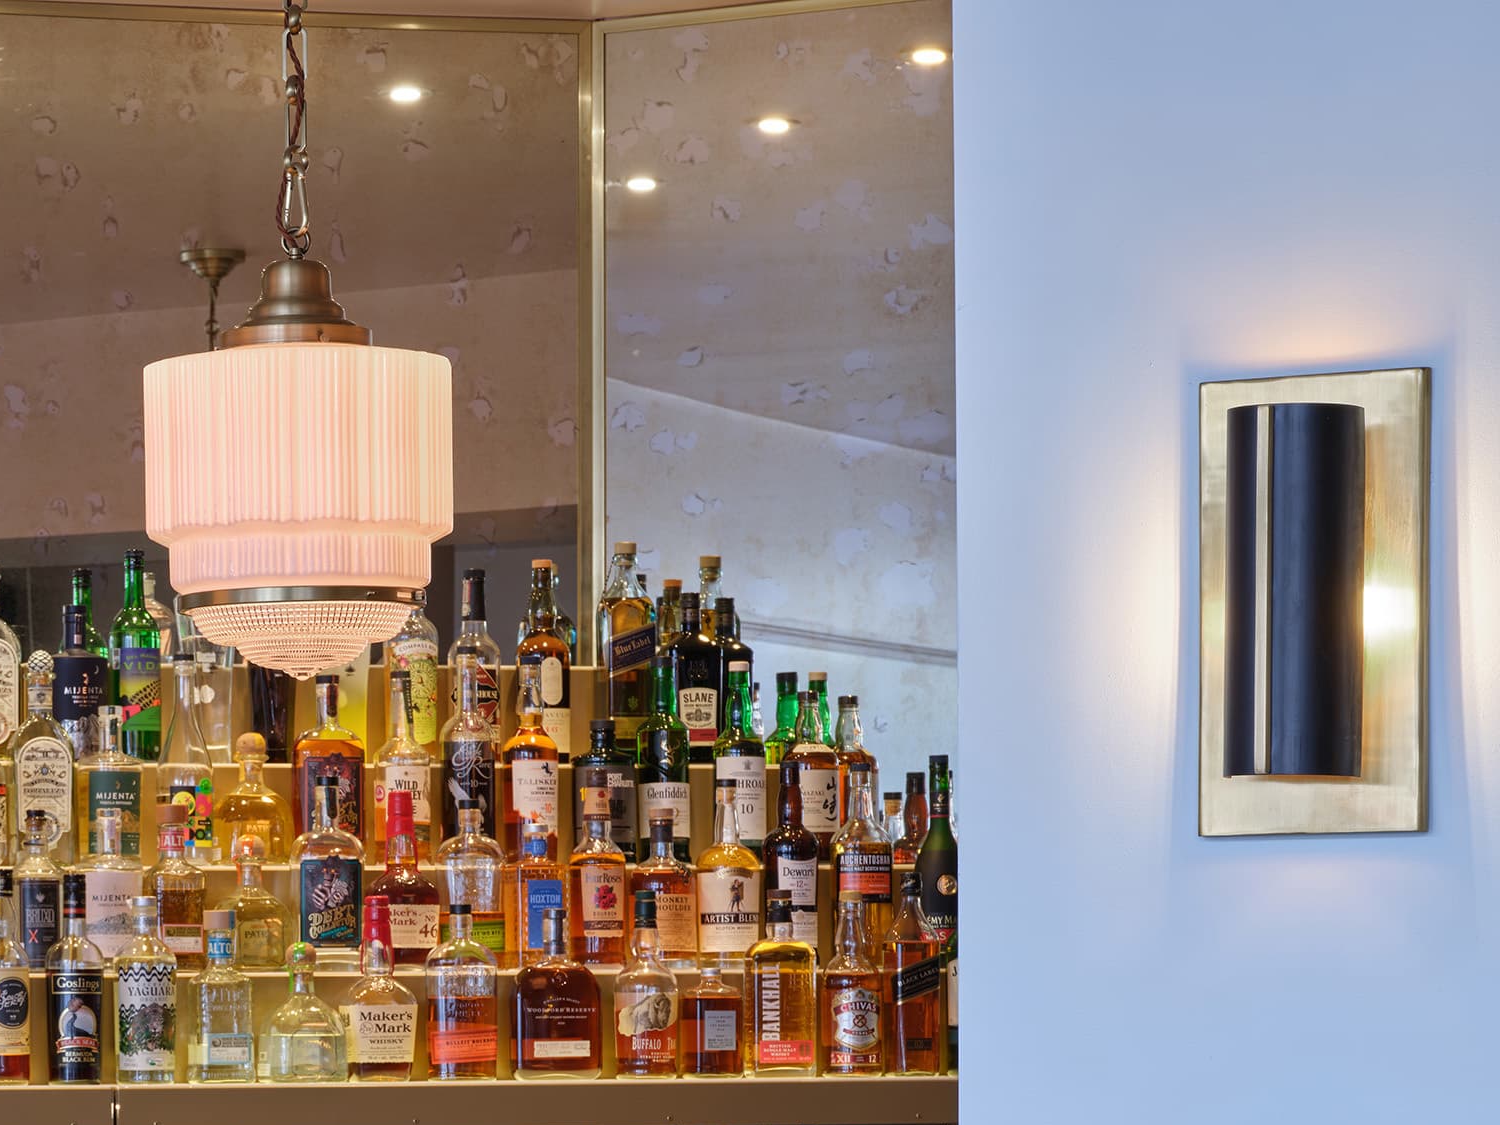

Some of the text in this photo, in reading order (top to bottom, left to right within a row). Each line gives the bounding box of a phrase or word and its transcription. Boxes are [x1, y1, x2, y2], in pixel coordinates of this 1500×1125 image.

[64, 687, 103, 695] MIJENTA
[683, 693, 714, 704] SLANE
[395, 780, 418, 790] WILD
[96, 792, 134, 801] MIJENTA
[741, 804, 754, 814] 10
[164, 836, 184, 847] ALT
[840, 854, 891, 866] AUCHENTOSHAN
[603, 872, 622, 882] Roses
[530, 894, 561, 904] HOXTON
[704, 914, 735, 923] ARTIST
[27, 929, 39, 943] X
[419, 924, 438, 939] 46
[208, 944, 232, 954] ALTO
[56, 976, 100, 993] Goslings
[762, 963, 780, 1041] BANKHALL
[840, 1002, 878, 1014] CHIVAS
[359, 1011, 413, 1022] Maker's
[374, 1023, 412, 1034] Mark
[632, 1036, 662, 1051] BUFFALO
[836, 1055, 851, 1064] XII
[868, 1054, 878, 1063] 12
